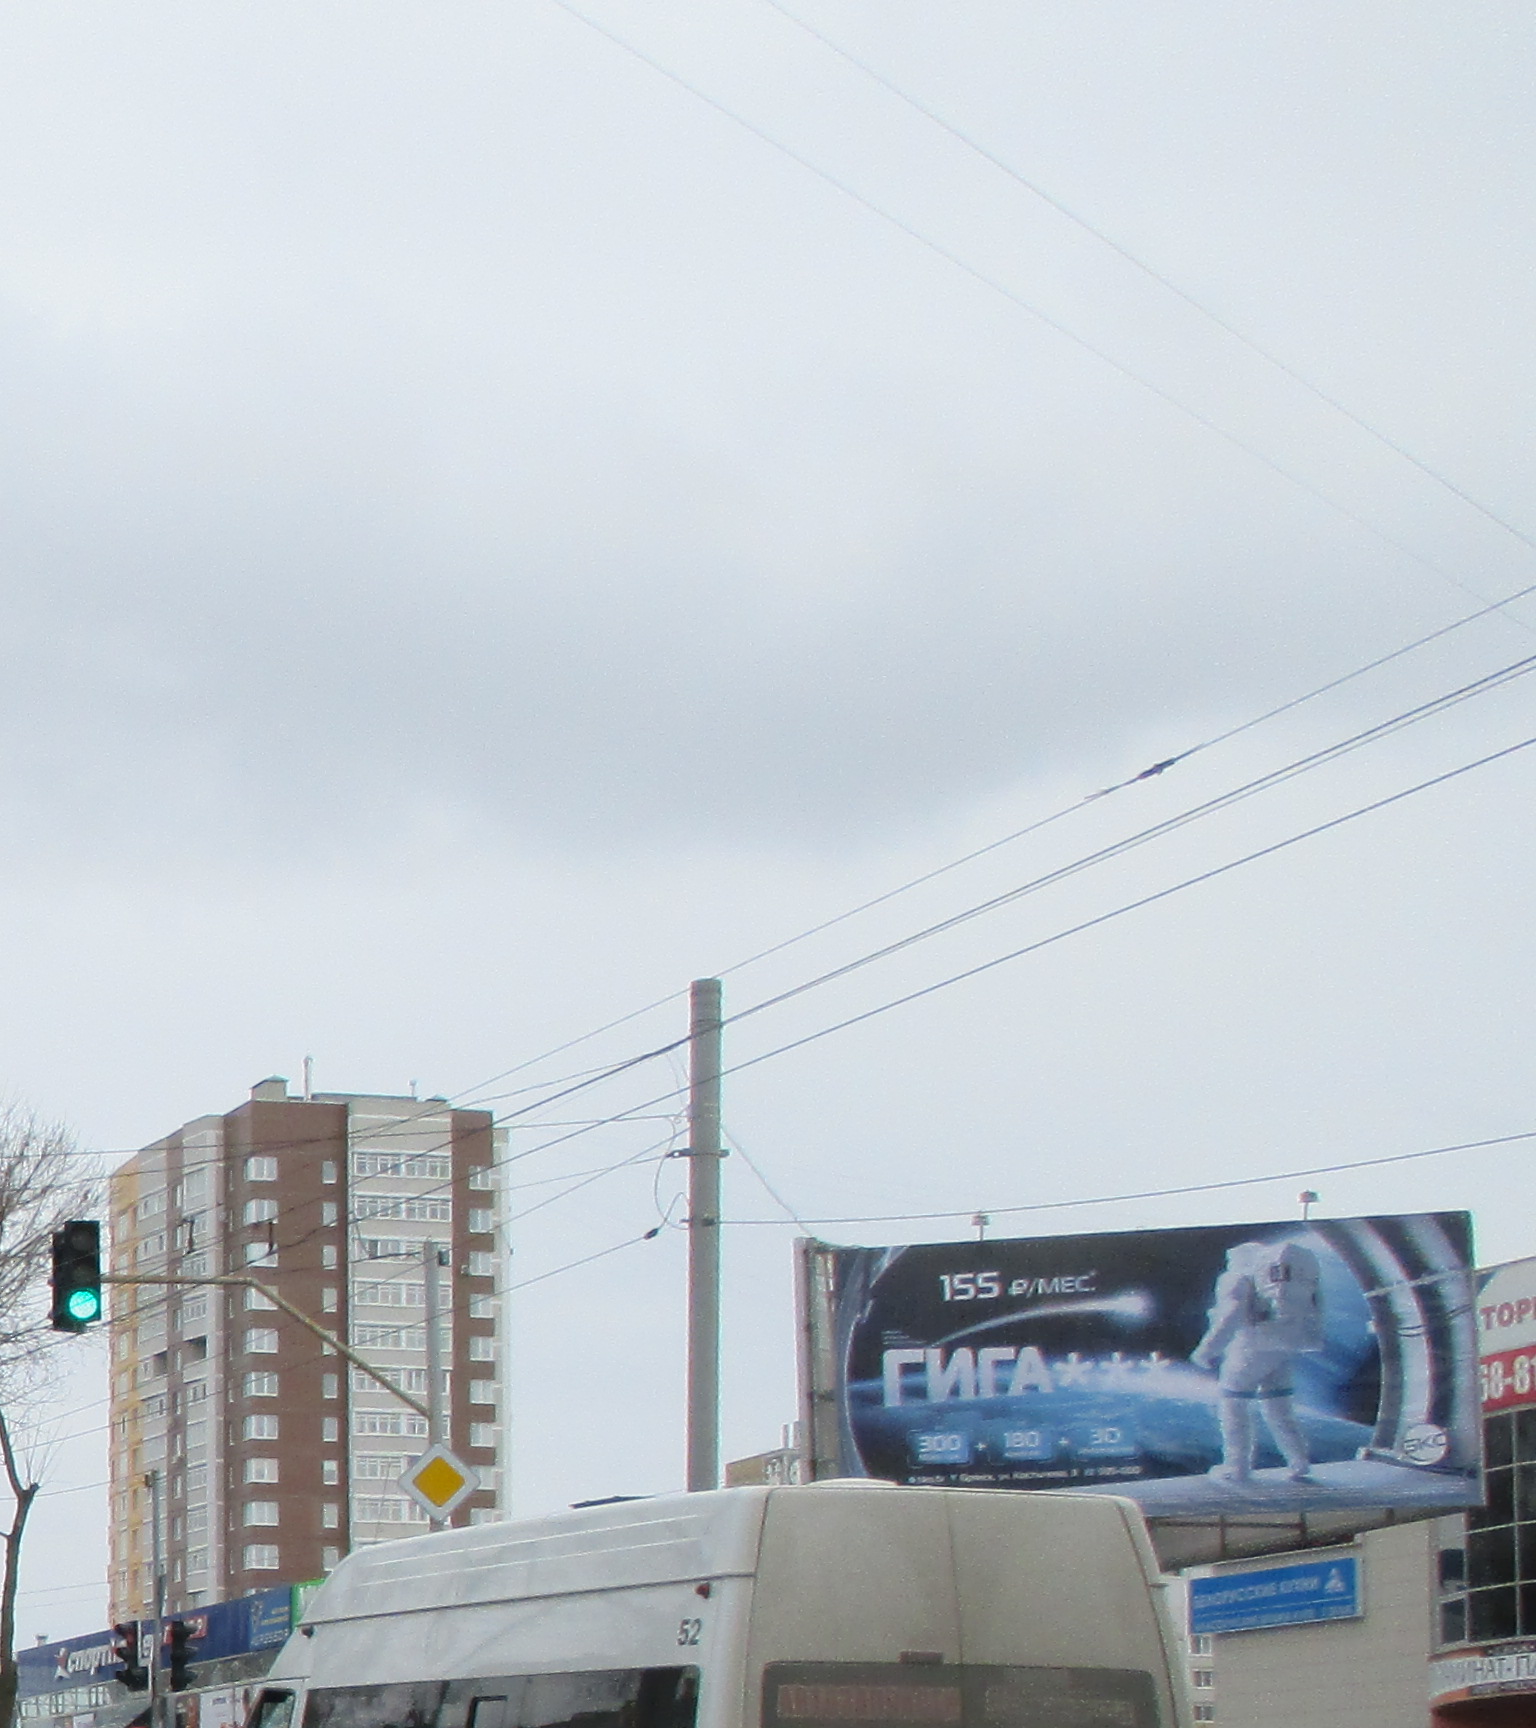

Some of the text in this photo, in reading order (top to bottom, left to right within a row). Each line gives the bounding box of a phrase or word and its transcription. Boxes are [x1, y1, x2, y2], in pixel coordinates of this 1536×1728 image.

[939, 1271, 1000, 1301] 155
[1480, 1295, 1536, 1330] ТОР
[677, 1618, 703, 1646] 52
